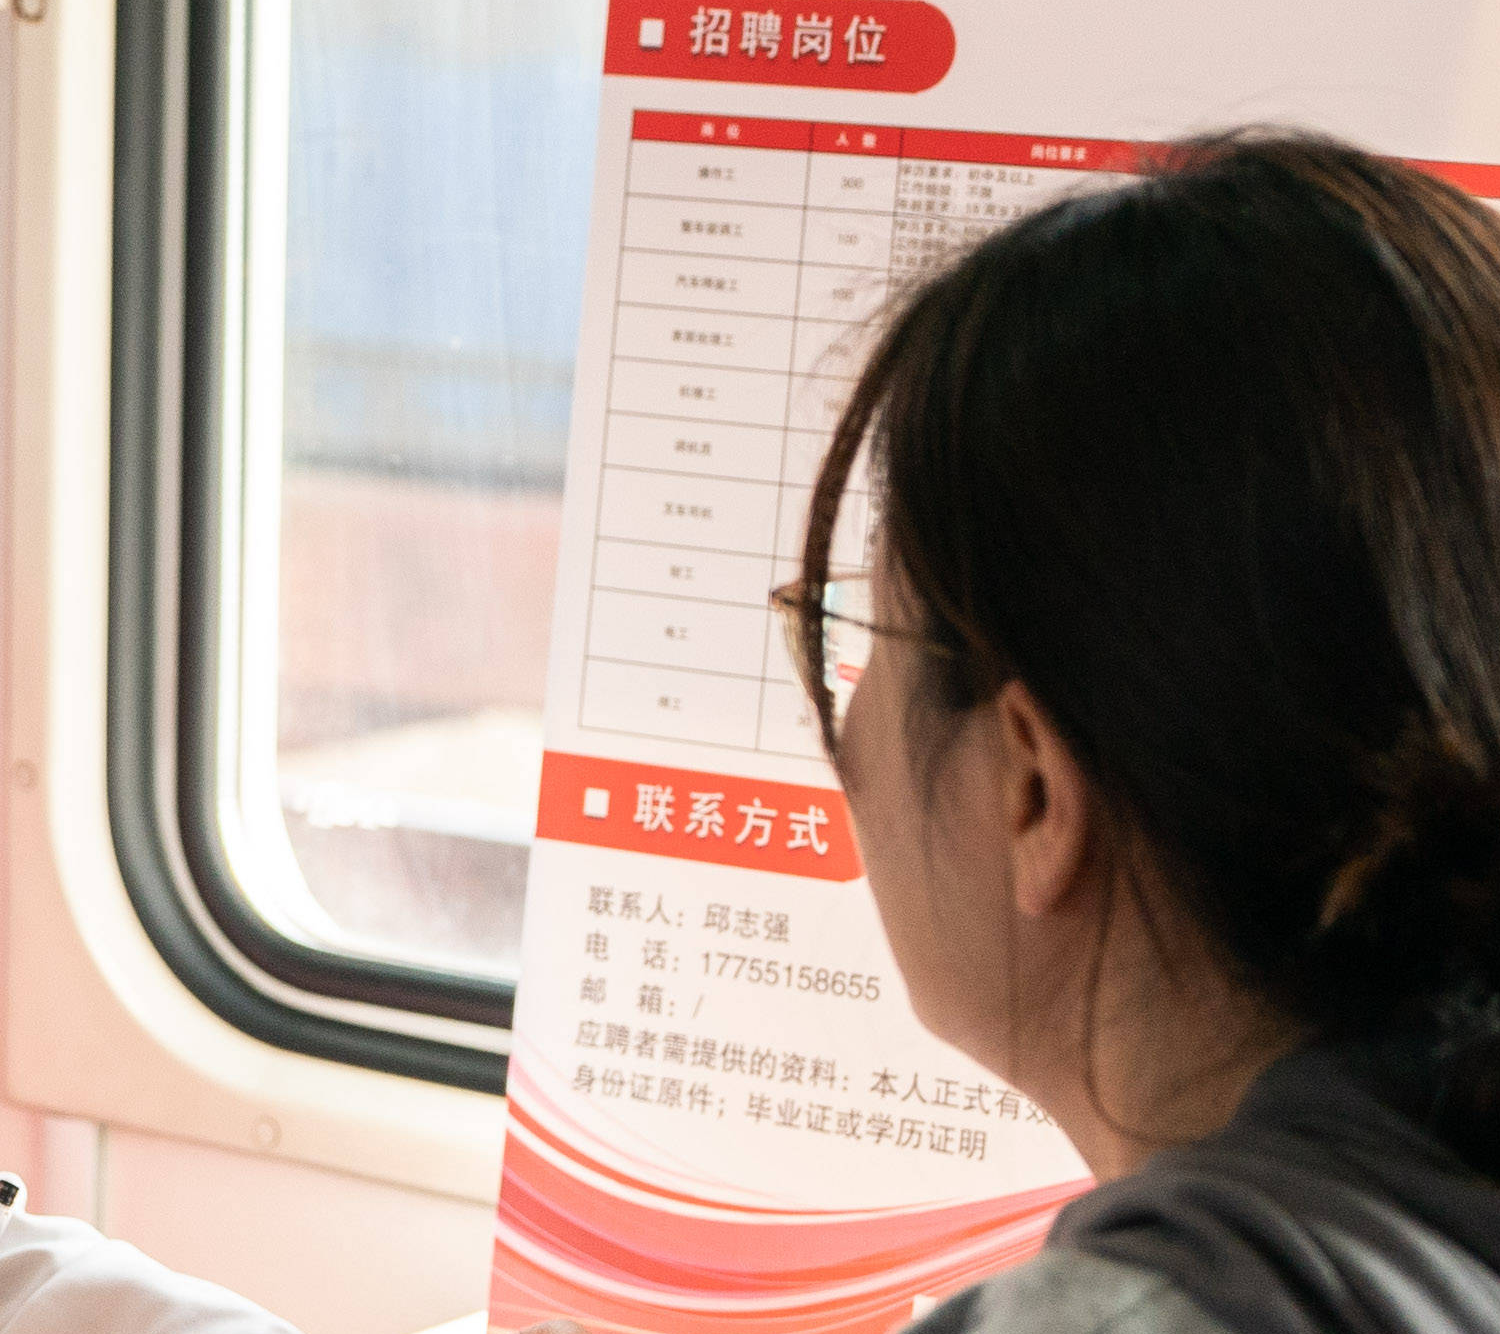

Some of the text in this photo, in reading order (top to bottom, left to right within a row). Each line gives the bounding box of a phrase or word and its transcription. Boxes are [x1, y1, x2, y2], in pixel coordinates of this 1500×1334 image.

[689, 6, 887, 64] 招聘岗位
[634, 783, 830, 855] 联系方式
